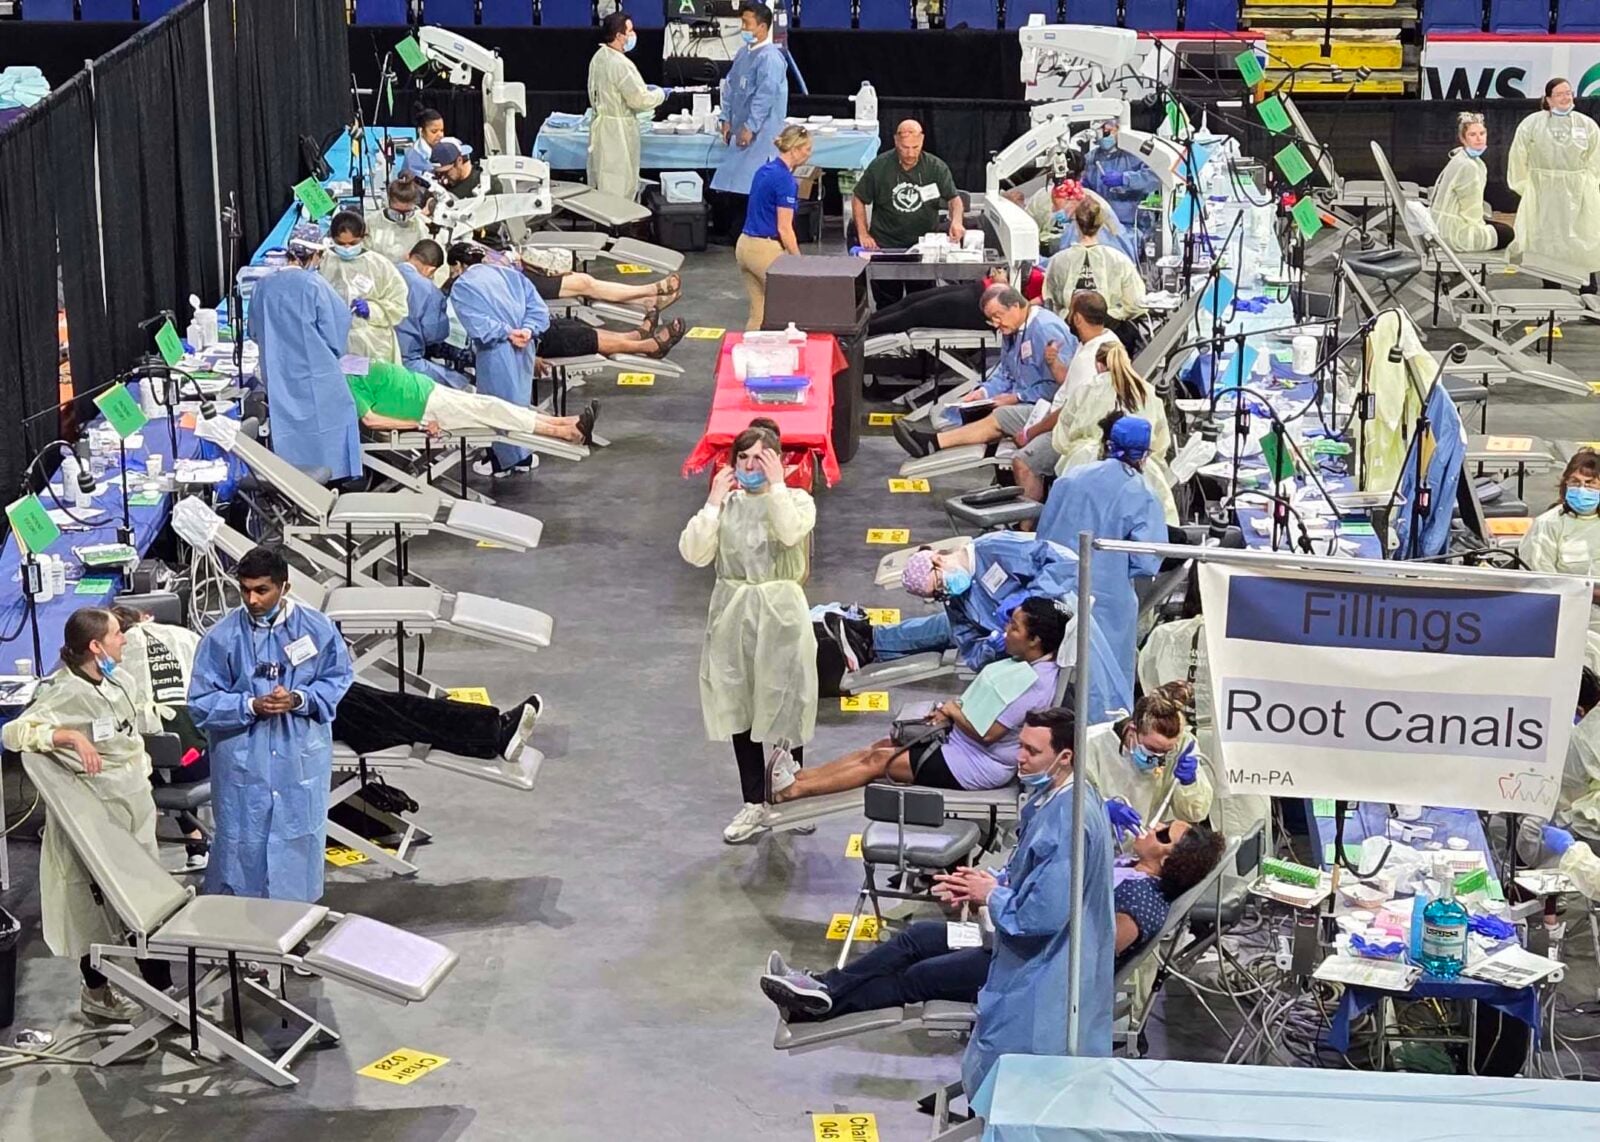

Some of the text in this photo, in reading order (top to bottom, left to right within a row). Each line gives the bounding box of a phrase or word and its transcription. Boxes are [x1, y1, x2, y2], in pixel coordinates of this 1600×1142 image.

[1302, 591, 1482, 652] Fillings
[1226, 689, 1543, 750] Root Canals
[1225, 769, 1294, 786] M-n-PA
[392, 1057, 439, 1080] Chair
[819, 1121, 841, 1139] 046
[849, 1116, 869, 1142] Chair
